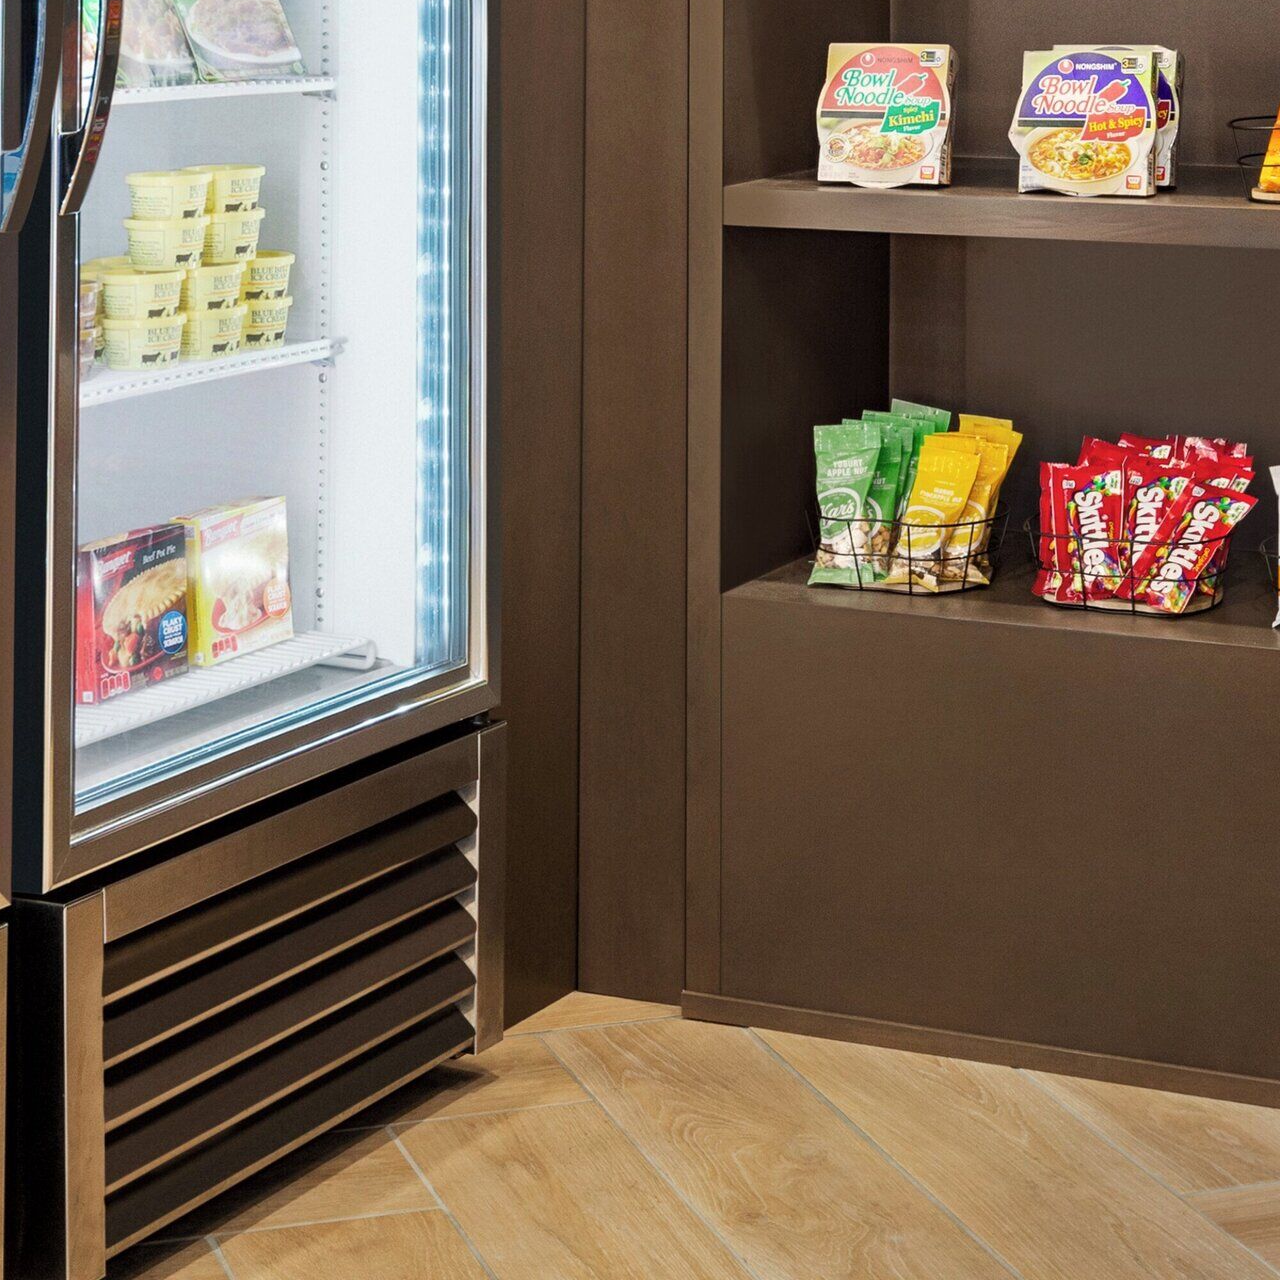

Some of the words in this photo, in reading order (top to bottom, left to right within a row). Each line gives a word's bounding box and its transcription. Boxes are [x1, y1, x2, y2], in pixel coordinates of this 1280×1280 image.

[1075, 62, 1116, 71] NONGSHIM
[843, 68, 896, 88] Bowl
[1040, 75, 1097, 95] Bowl
[835, 86, 904, 105] Noodle
[904, 95, 931, 106] Soup
[1032, 94, 1107, 114] Noodle
[1106, 103, 1136, 115] Soup
[888, 110, 935, 127] Kimchi
[1088, 120, 1108, 132] Hot
[1109, 119, 1118, 129] &
[1118, 116, 1144, 130] Spicy
[250, 267, 270, 275] BLUE
[251, 309, 271, 317] BLUE
[832, 457, 863, 467] YOGURT
[826, 467, 852, 477] APPLE
[1074, 490, 1111, 582] Skittles
[142, 552, 155, 565] Beef
[166, 544, 176, 556] Pie
[1149, 500, 1220, 594] Skittles
[162, 617, 182, 629] FLAKY
[163, 625, 184, 635] CRUST
